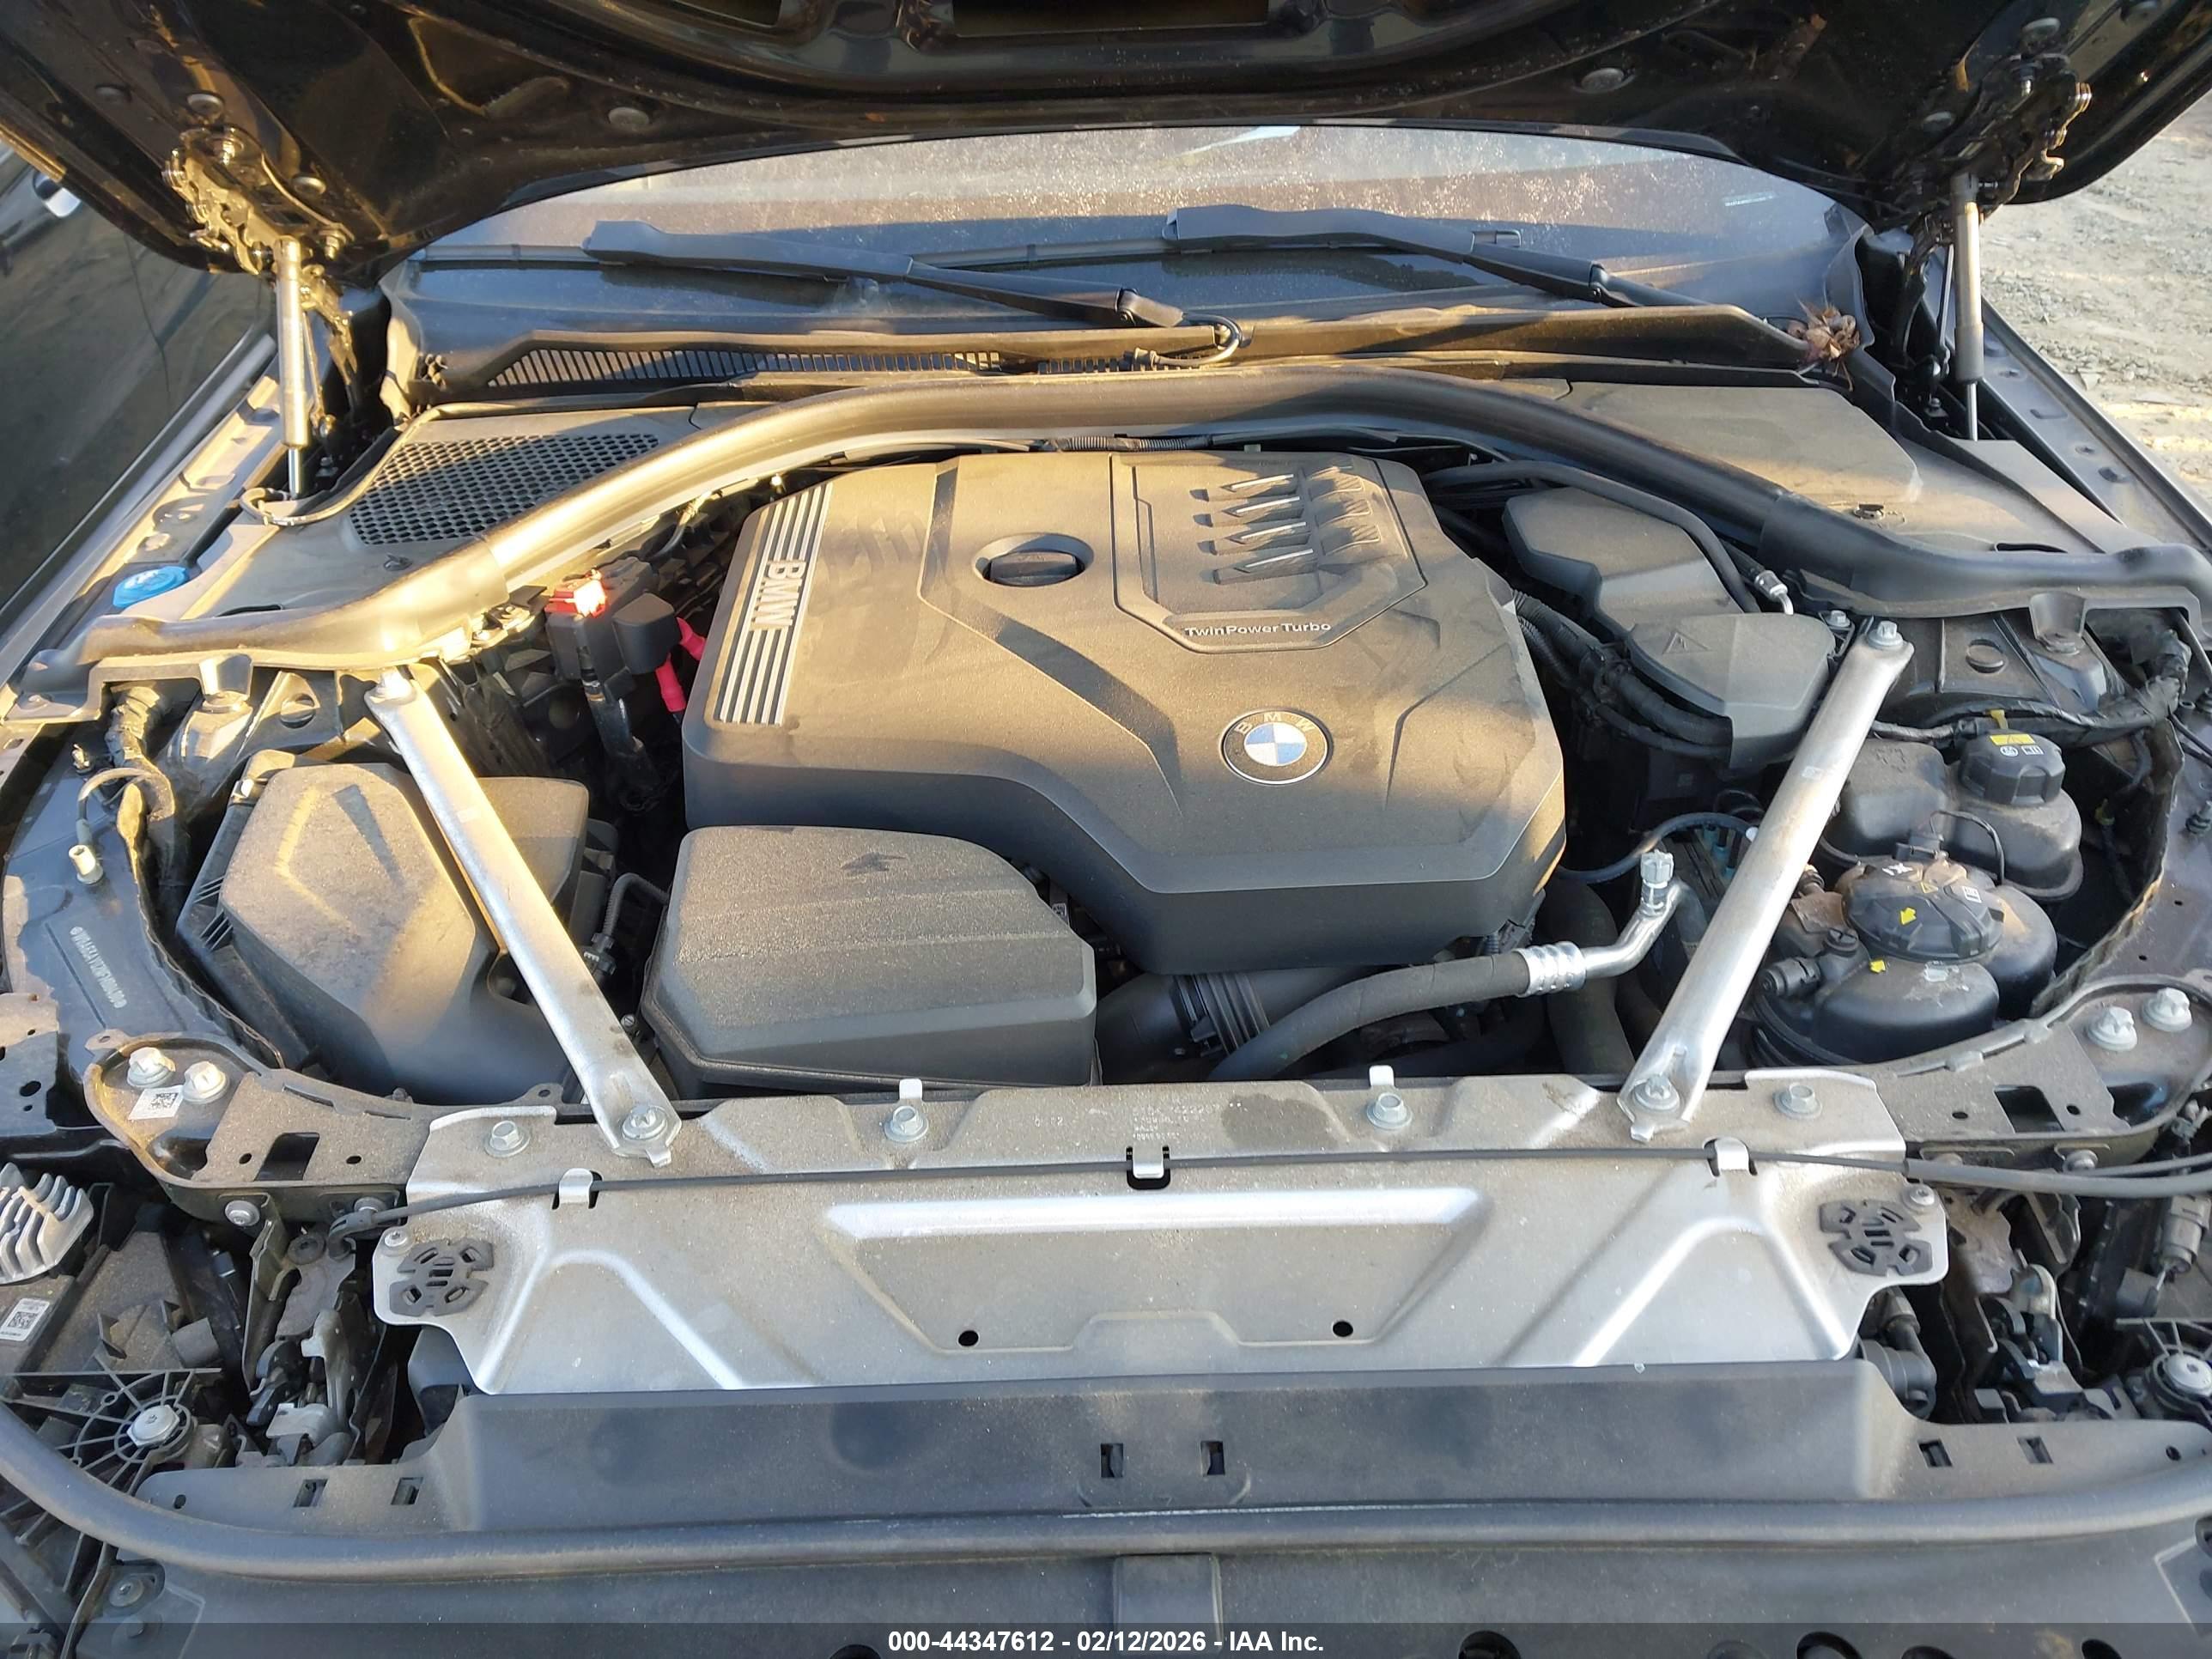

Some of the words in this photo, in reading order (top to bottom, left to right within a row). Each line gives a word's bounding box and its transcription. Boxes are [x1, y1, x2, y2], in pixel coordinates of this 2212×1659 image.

[752, 560, 806, 627] BMW
[1185, 624, 1279, 637] TwinPower
[1281, 622, 1332, 633] Turbo
[1234, 713, 1317, 736] BMW
